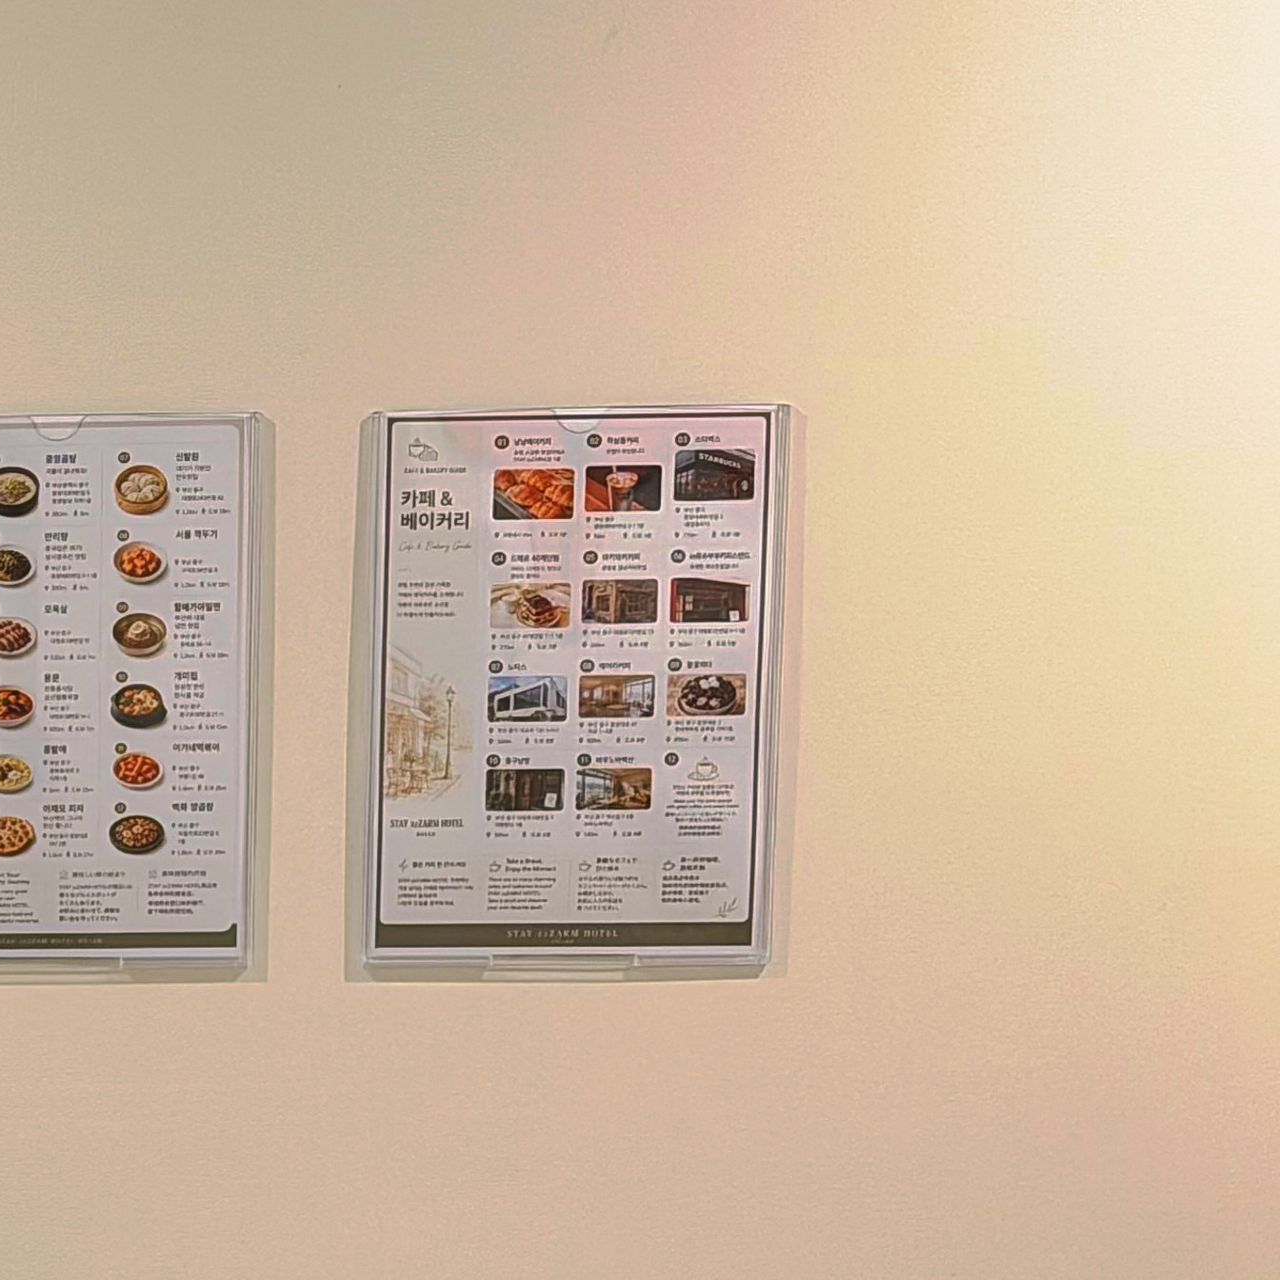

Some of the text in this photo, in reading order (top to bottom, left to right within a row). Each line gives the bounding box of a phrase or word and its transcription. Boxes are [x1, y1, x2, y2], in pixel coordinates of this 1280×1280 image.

[401, 489, 453, 508] 카페 &
[401, 511, 469, 530] 베이커리
[390, 820, 408, 828] STAY
